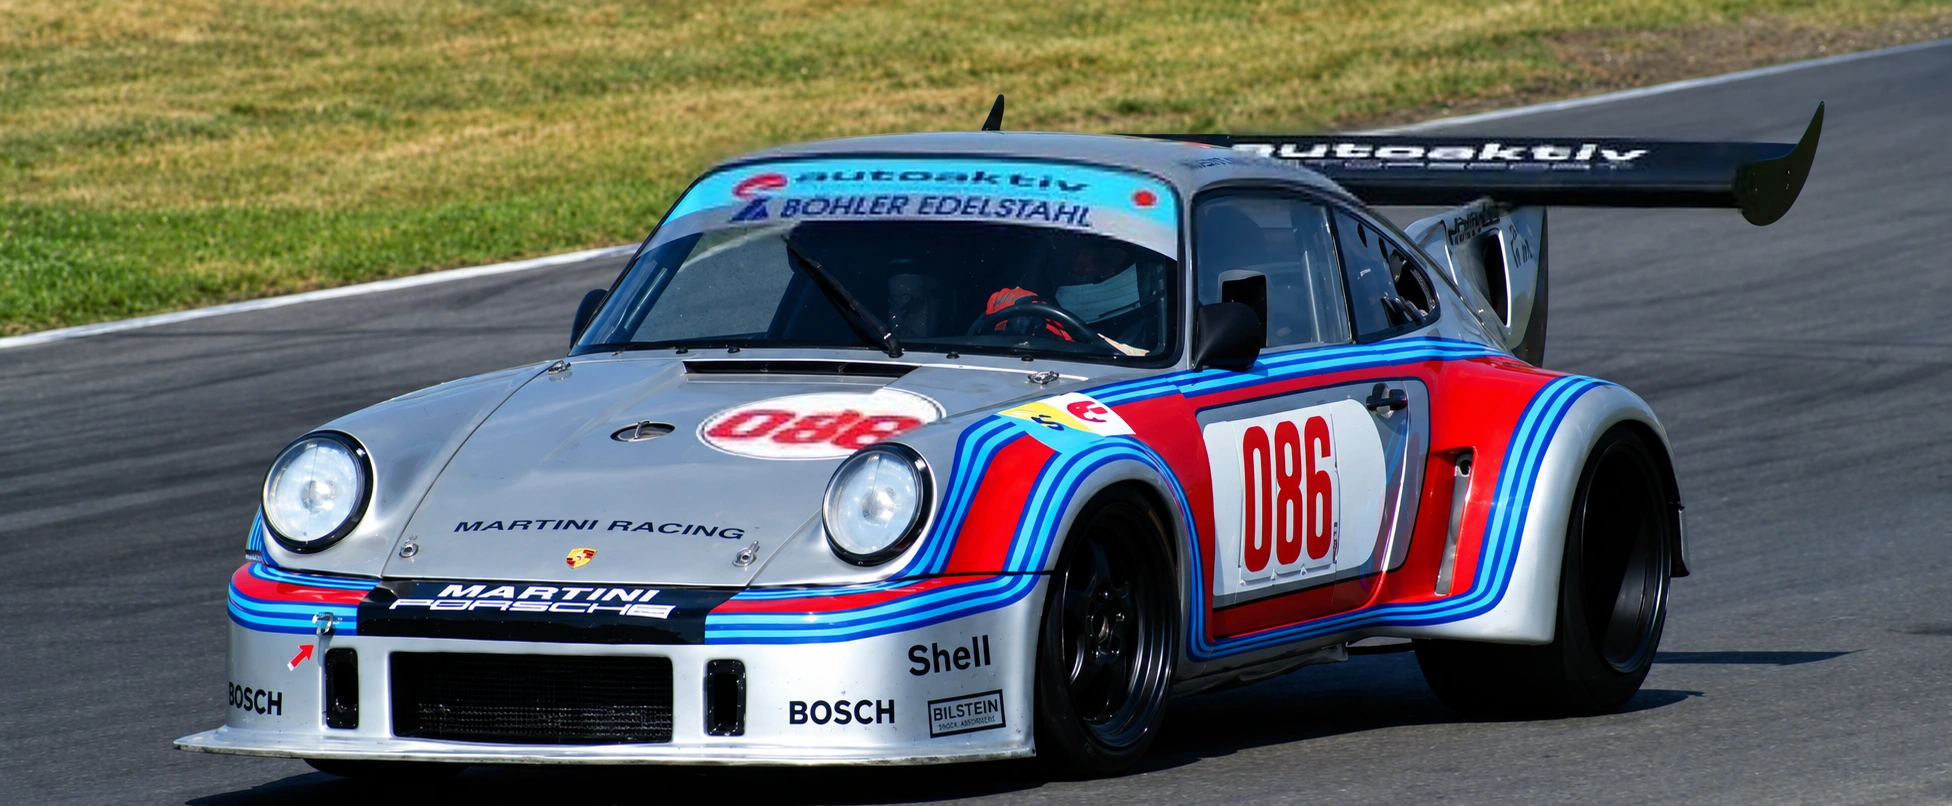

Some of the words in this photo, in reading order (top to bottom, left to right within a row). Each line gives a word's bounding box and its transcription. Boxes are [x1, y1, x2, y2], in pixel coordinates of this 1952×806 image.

[1231, 143, 1648, 161] autoaktiv
[795, 170, 1088, 191] autoaktiv
[918, 196, 1091, 227] EDELSTAHL
[1242, 415, 1332, 572] 086
[454, 519, 599, 533] MARTINI
[607, 520, 745, 540] RACING
[437, 584, 660, 602] MARTINI
[388, 598, 676, 619] PORSCHE
[908, 634, 991, 676] Shell
[228, 681, 283, 716] BOSCH
[789, 699, 895, 725] BOSCH
[933, 699, 998, 721] BILSTEIN
